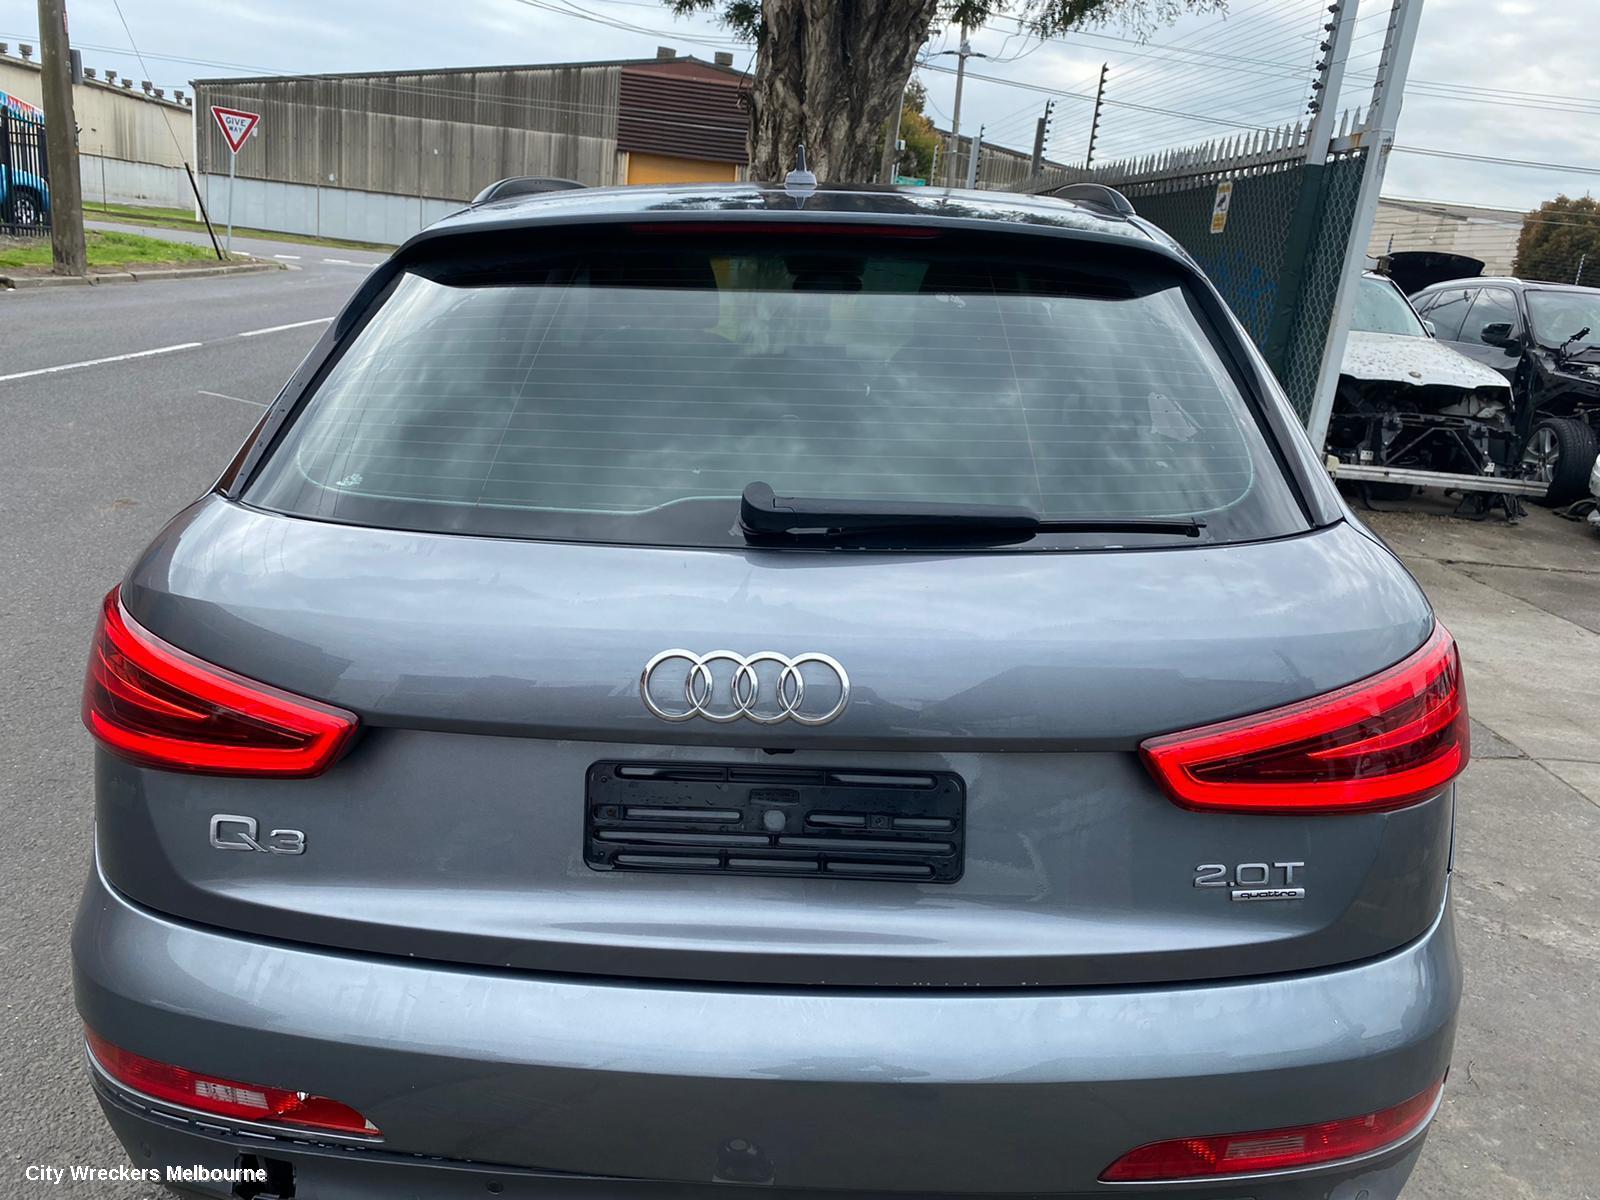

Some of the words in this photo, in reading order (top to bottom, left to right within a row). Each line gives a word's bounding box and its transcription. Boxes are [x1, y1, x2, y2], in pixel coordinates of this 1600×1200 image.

[225, 116, 246, 127] GIVE
[210, 813, 305, 855] Q3
[1195, 862, 1304, 887] 2.0T
[1240, 890, 1297, 899] quattro
